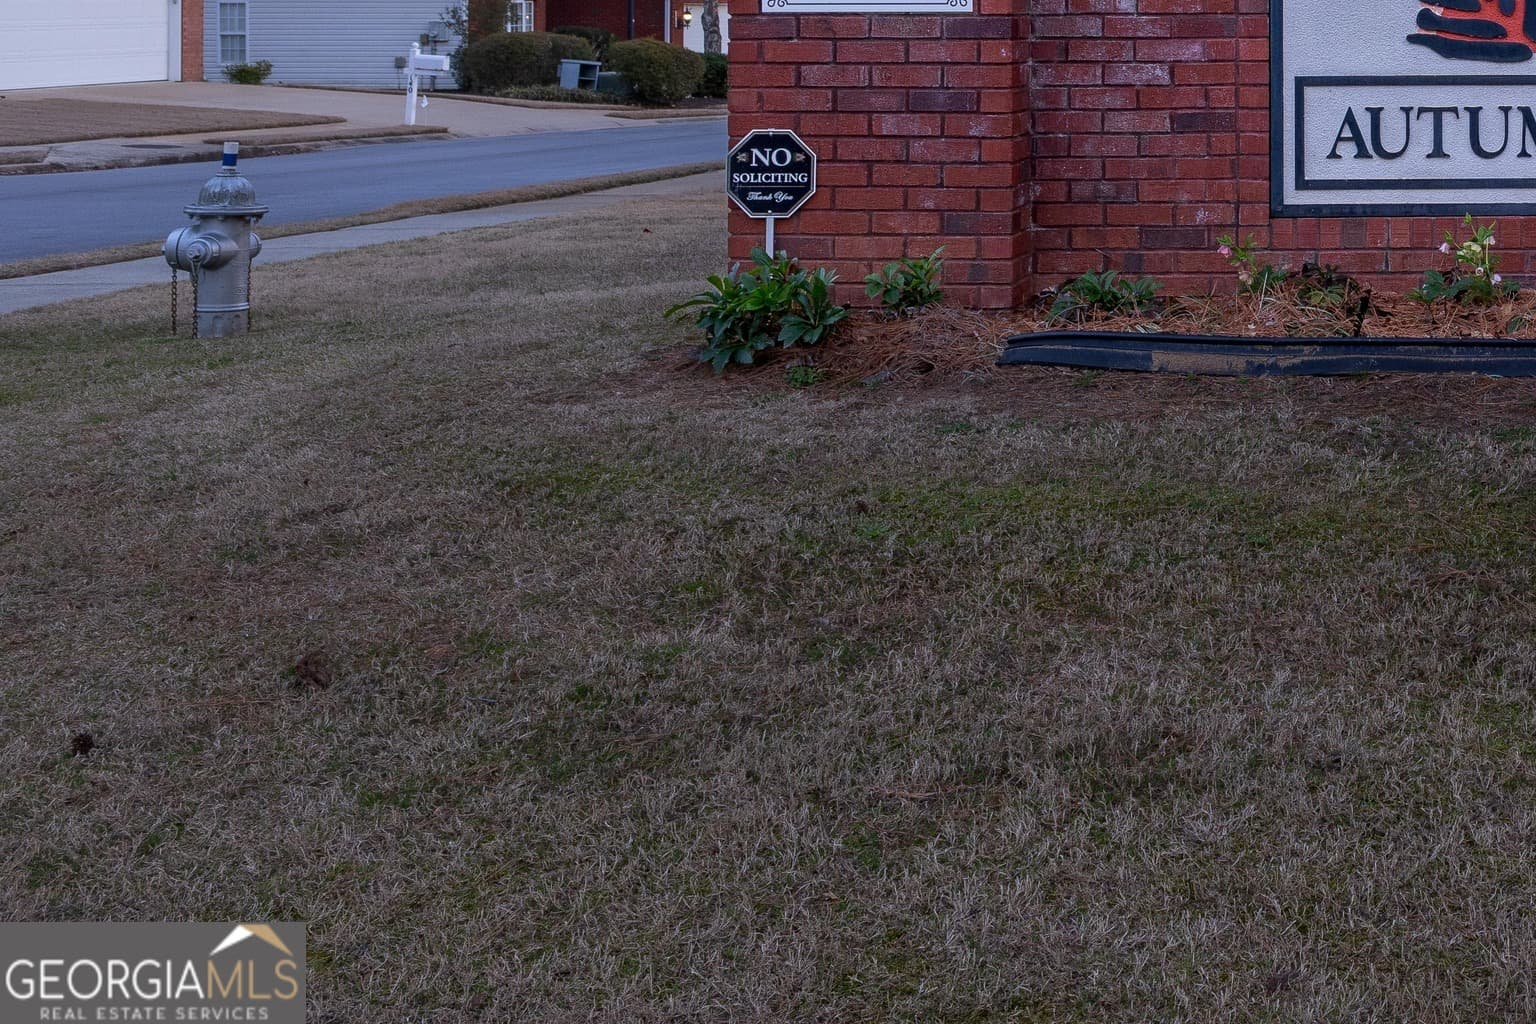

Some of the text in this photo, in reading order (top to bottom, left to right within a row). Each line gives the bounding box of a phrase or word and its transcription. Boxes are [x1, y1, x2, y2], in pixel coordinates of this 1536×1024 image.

[750, 147, 792, 167] NO
[732, 172, 808, 184] SOLICITING
[746, 190, 794, 203] Thank You
